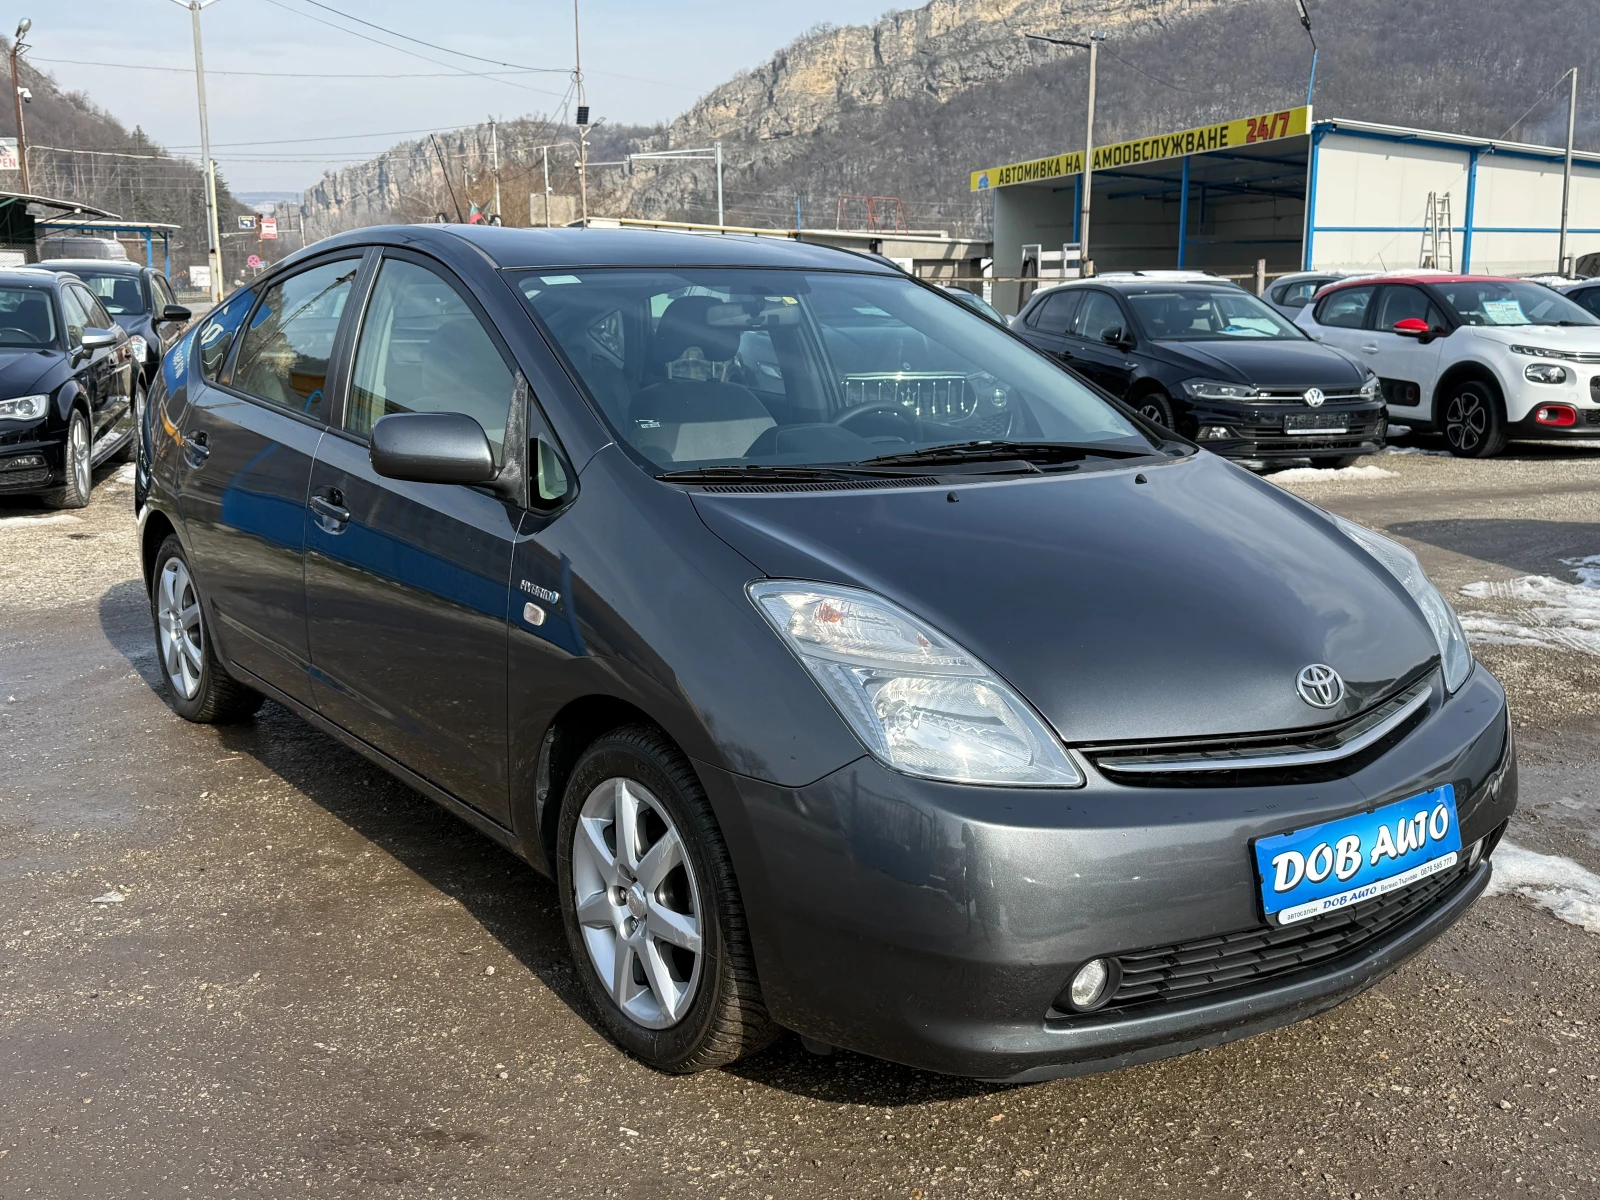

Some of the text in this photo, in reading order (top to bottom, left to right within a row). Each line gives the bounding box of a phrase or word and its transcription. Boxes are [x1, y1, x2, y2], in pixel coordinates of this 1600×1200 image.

[0, 157, 16, 168] EN
[998, 111, 1290, 186] АВТОМИВКА НА АМООБСЛУЖВАНЕ 24/7
[1272, 803, 1449, 894] DOB AUTO
[1322, 895, 1348, 909] DOB
[1349, 886, 1377, 902] AUTO
